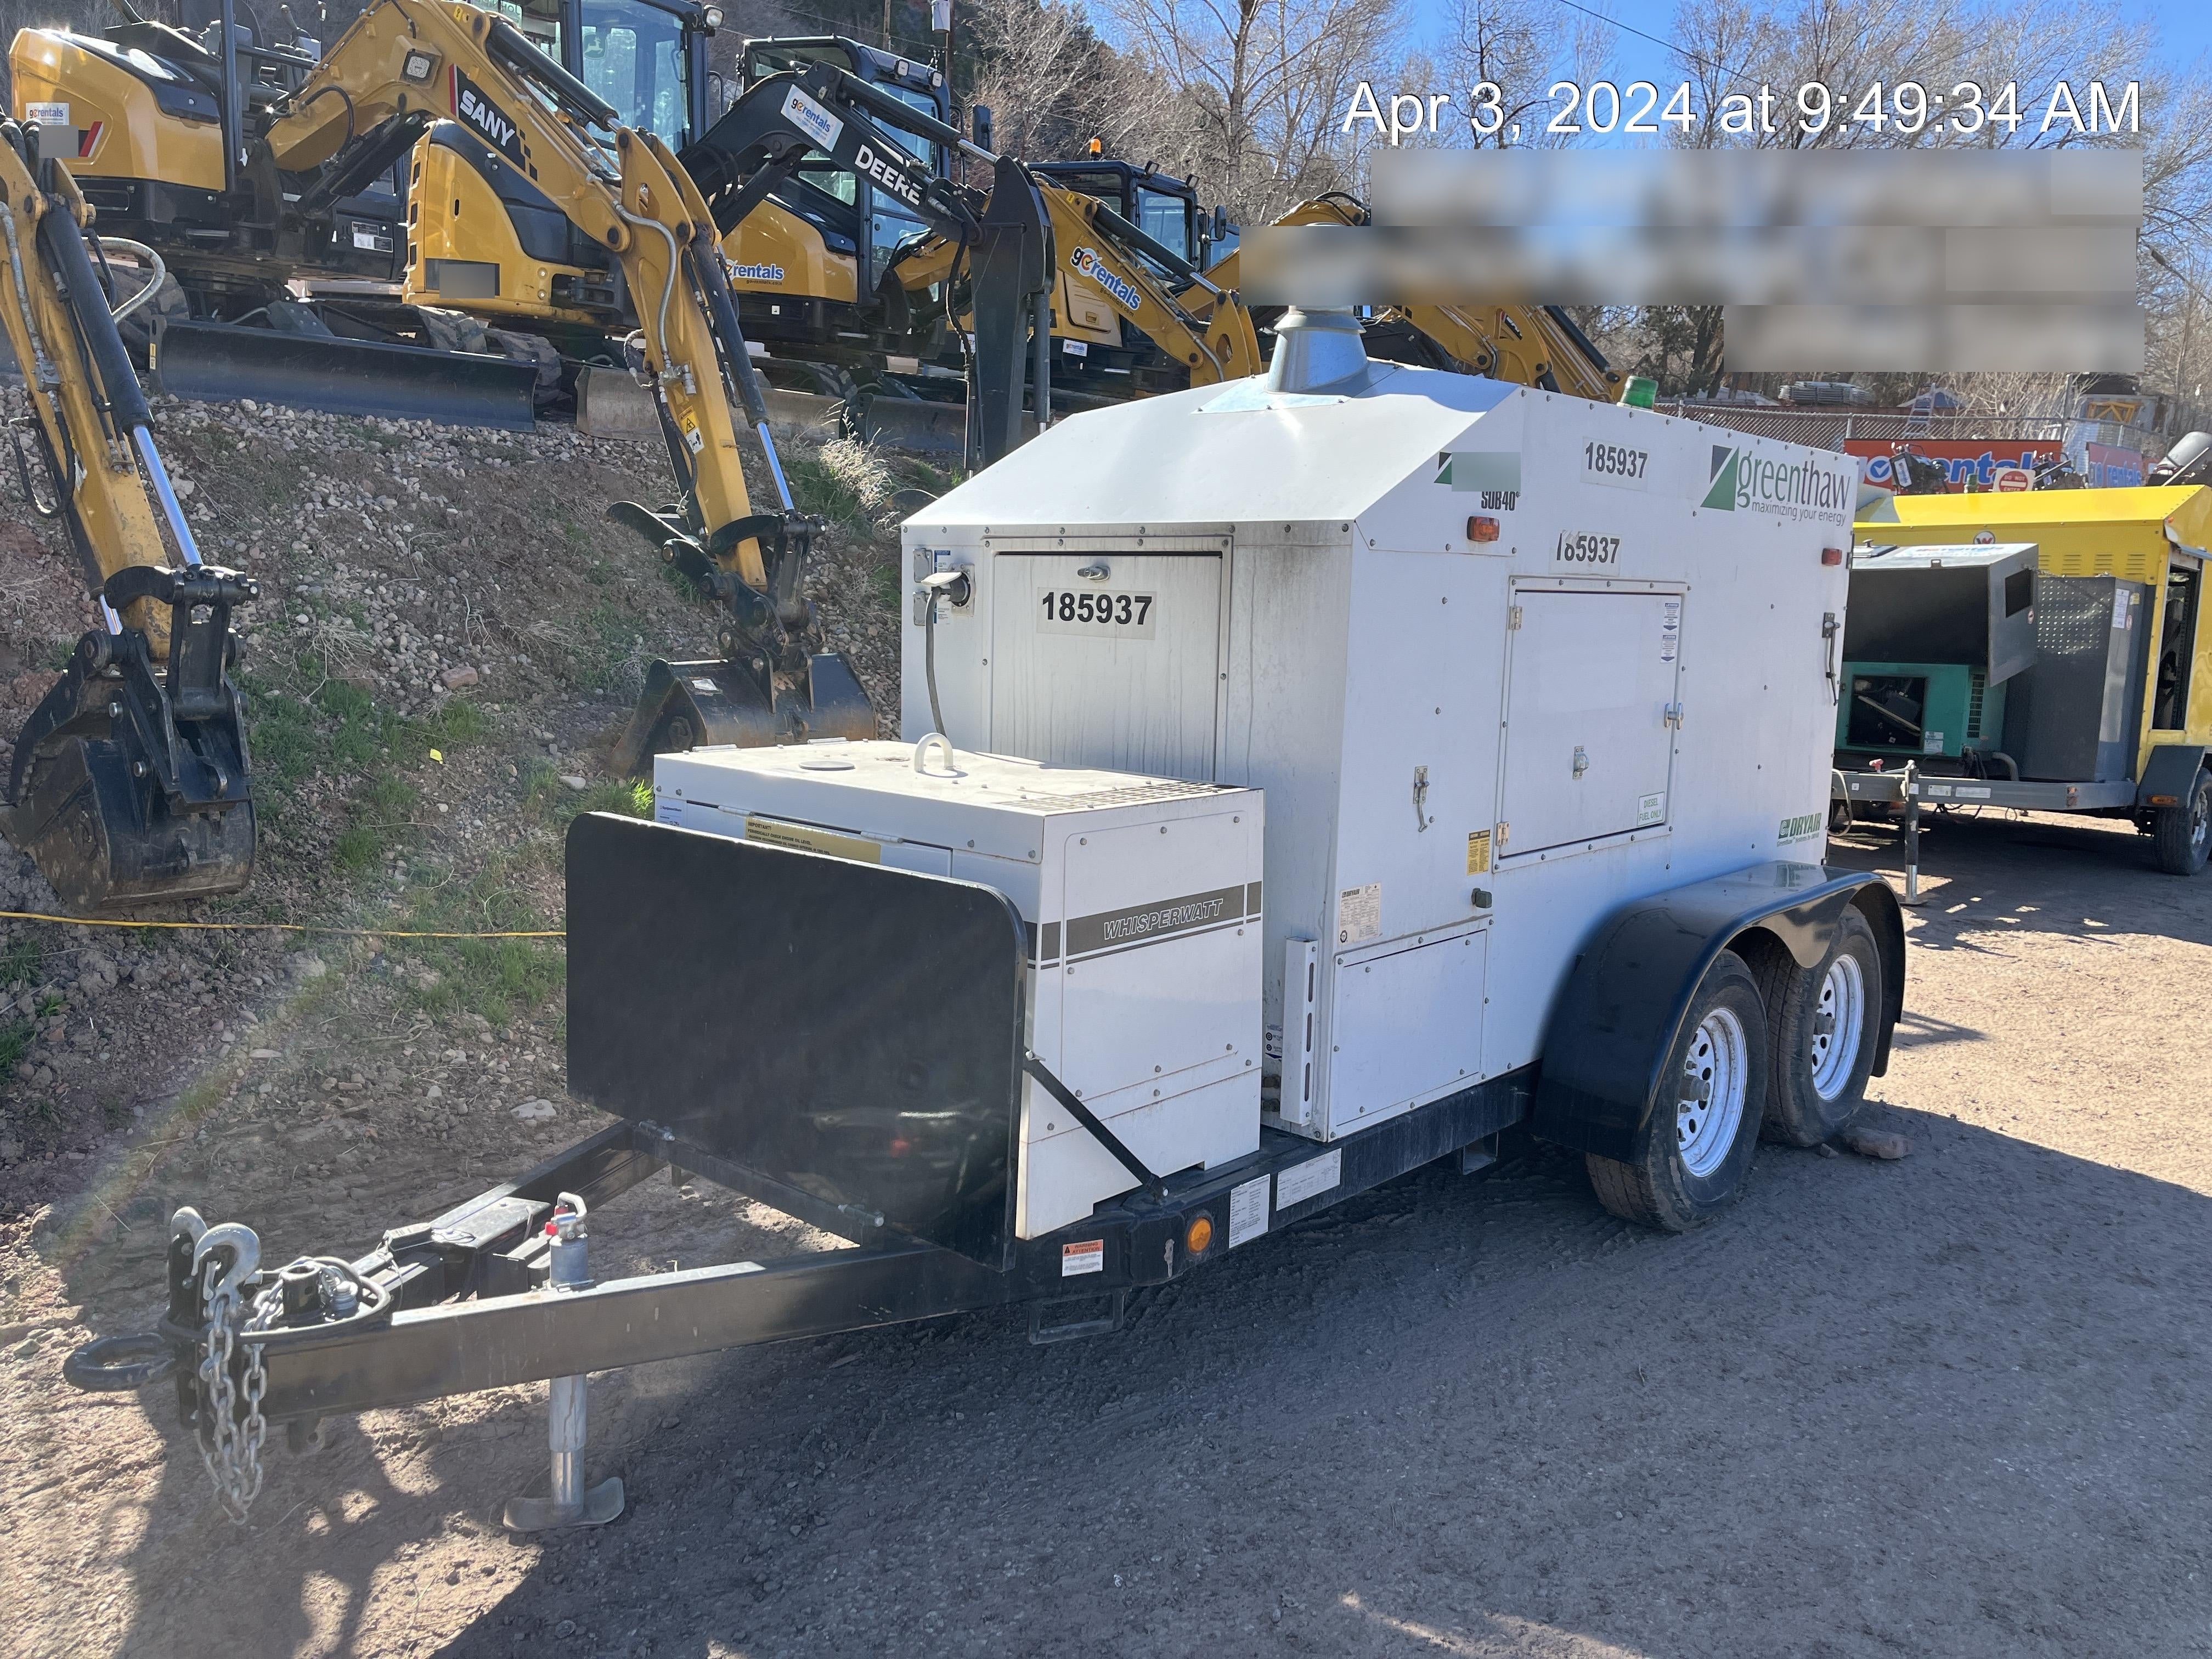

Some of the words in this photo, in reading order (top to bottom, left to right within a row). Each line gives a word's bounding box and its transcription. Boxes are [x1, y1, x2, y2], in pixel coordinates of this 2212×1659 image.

[460, 90, 515, 146] SANY
[855, 144, 923, 206] DEERE
[1585, 442, 1647, 478] 185937
[1737, 450, 1850, 508] greenthaw
[1752, 500, 1797, 521] maximizing
[1799, 506, 1817, 521] your
[1819, 509, 1846, 527] energy
[1042, 592, 1152, 625] 185937
[1639, 812, 1649, 822] FUEL
[1651, 809, 1662, 819] ONLY
[1644, 798, 1658, 809] DIESEL
[1790, 812, 1822, 837] DRYAIR
[1104, 898, 1224, 941] WHISPERWATT
